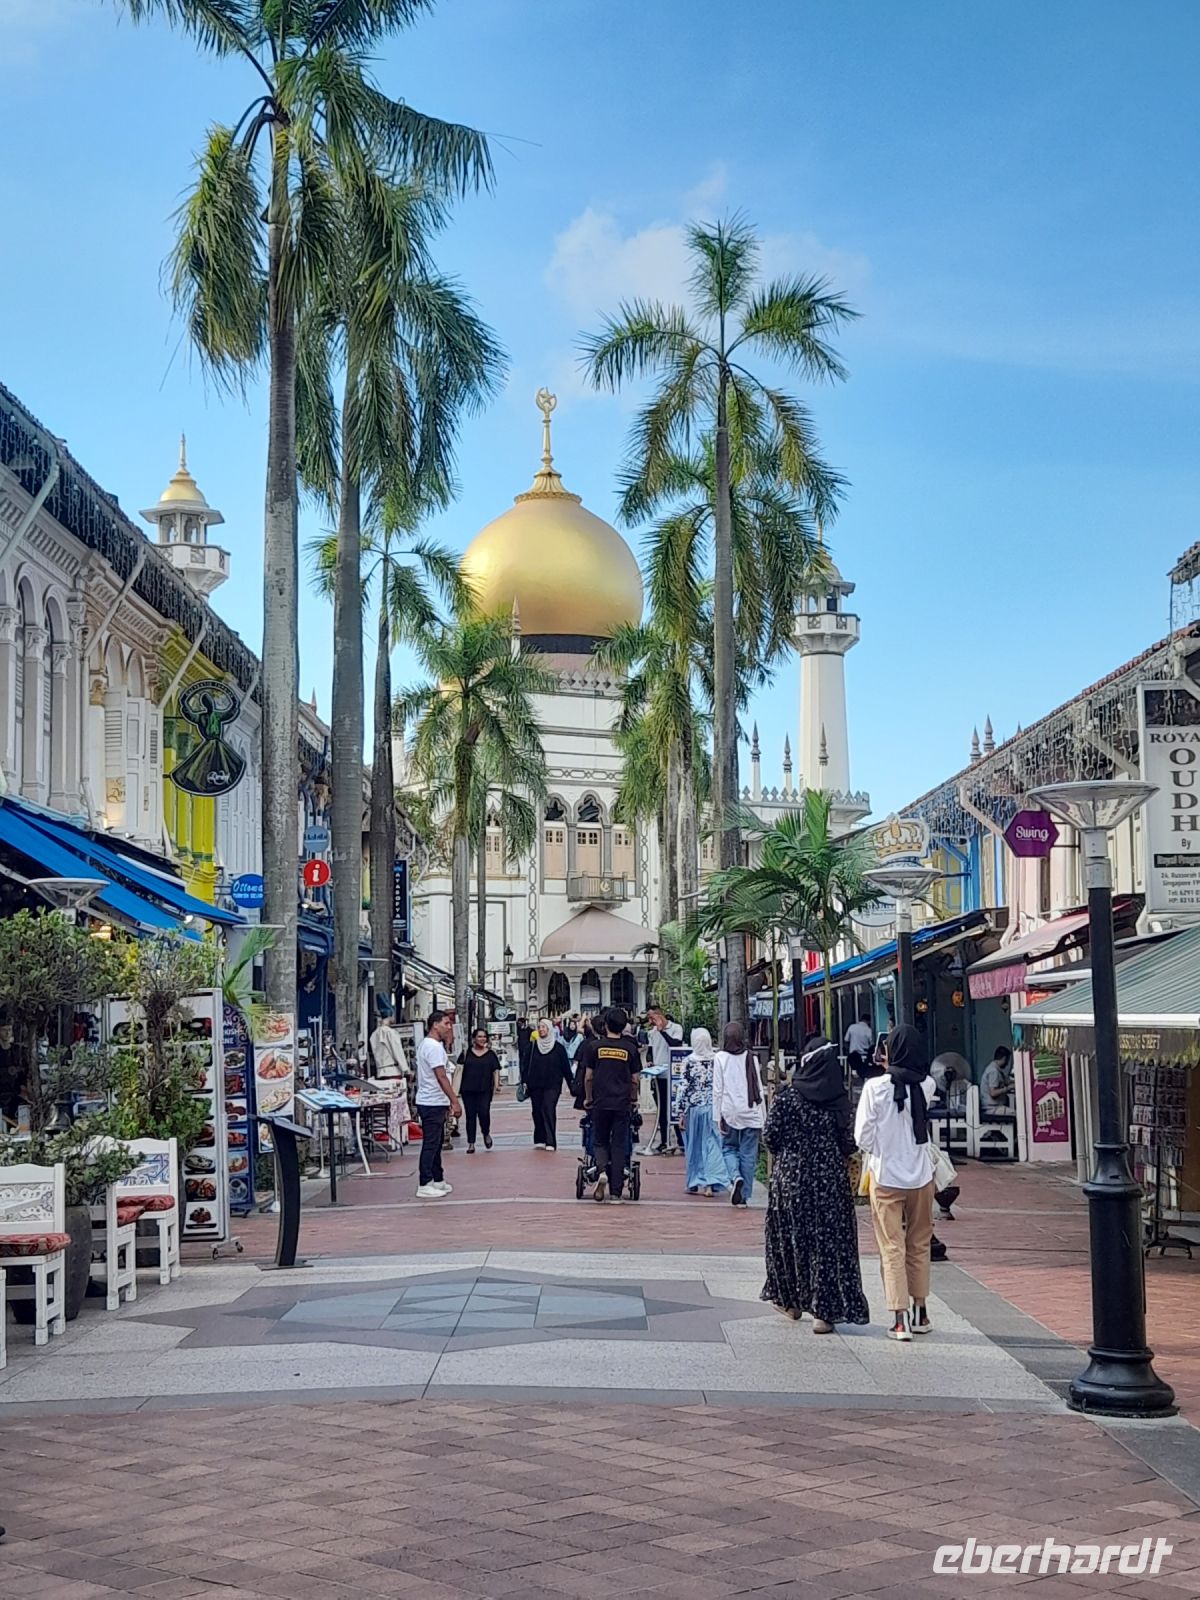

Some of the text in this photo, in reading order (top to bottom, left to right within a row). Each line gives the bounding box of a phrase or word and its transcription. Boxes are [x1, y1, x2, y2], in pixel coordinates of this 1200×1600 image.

[1169, 748, 1200, 832] OUDH
[1015, 825, 1049, 842] Swing
[1181, 838, 1191, 850] By
